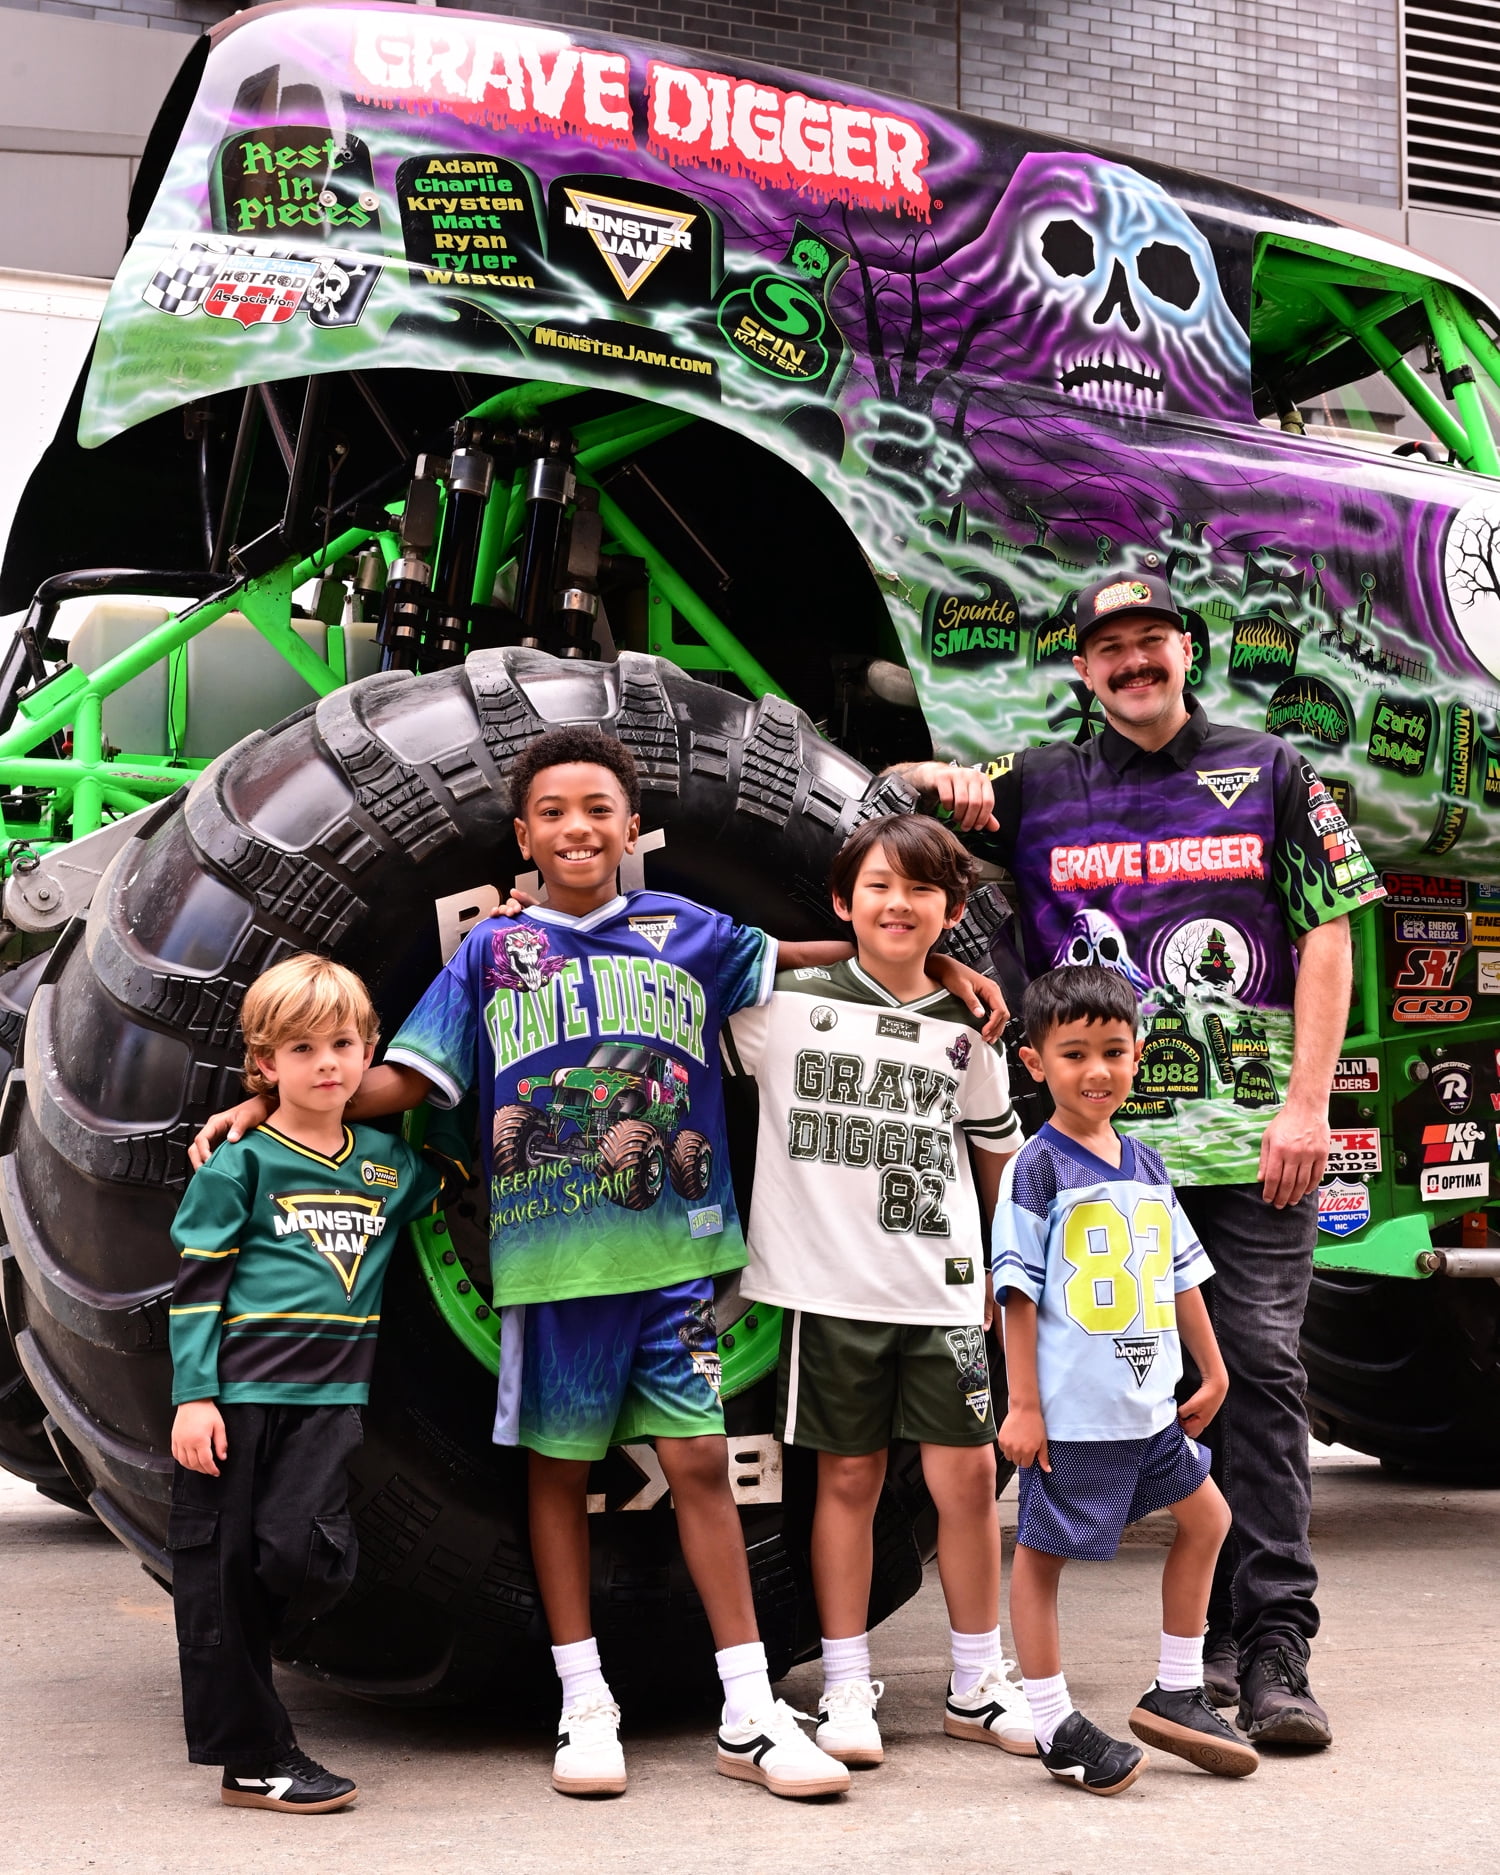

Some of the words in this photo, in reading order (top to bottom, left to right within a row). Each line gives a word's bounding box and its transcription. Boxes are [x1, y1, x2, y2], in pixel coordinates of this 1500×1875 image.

[353, 22, 631, 133] GRAVE
[650, 63, 924, 195] DIGGER
[239, 138, 343, 175] Rest
[426, 160, 498, 174] Adam
[279, 170, 314, 202] in
[414, 176, 513, 192] Charlie
[406, 196, 524, 213] Krysten
[235, 197, 371, 232] Pieces
[432, 215, 502, 230] Matt
[564, 206, 692, 251] MONSTER
[435, 234, 508, 252] Ryan
[599, 238, 658, 263] JAM
[431, 254, 518, 271] Tyler
[220, 270, 261, 284] HOT
[262, 274, 306, 289] ROD
[423, 270, 536, 289] Weston
[212, 289, 295, 309] Association
[740, 315, 807, 366] SPIN
[1099, 586, 1129, 600] GRAVE
[1099, 593, 1130, 609] DIGGER
[938, 596, 1016, 629] Sparkle
[933, 627, 1016, 658] SMASH
[1232, 641, 1295, 672] DRAGON
[1375, 705, 1426, 741] Earth
[1370, 733, 1425, 765] Shaker
[1449, 706, 1471, 796] MONSTER
[1198, 773, 1260, 787] MONSTER
[1214, 784, 1244, 793] JAM
[1051, 843, 1142, 883] GRAVE
[1147, 836, 1262, 874] DIGGER
[1386, 873, 1463, 897] DERALE
[1387, 894, 1463, 905] PERFORMANCE
[628, 922, 678, 932] MONSTER
[1429, 921, 1457, 931] ENERGY
[1475, 915, 1500, 927] ENE
[641, 929, 669, 938] JAM
[1429, 930, 1459, 940] RELEASE
[589, 955, 708, 1070] DIGGER
[1397, 998, 1469, 1014] CRD
[1155, 1017, 1182, 1030] RIP
[1207, 1016, 1227, 1057] MONSTER
[1139, 1037, 1201, 1064] ESTABLISHED
[1162, 1051, 1174, 1061] IN
[1140, 1063, 1199, 1084] 1982
[1334, 1061, 1363, 1075] OLN
[1241, 1071, 1271, 1088] Earth
[1332, 1078, 1371, 1090] LDERS
[1166, 1084, 1198, 1093] ANDERSON
[1237, 1086, 1275, 1101] Shaker
[1118, 1100, 1166, 1115] ZOMBIE
[1445, 1121, 1486, 1142] K&
[789, 1109, 956, 1181] DIGGER
[1450, 1141, 1475, 1161] N
[1328, 1151, 1377, 1161] ROD
[1325, 1161, 1378, 1172] NDS
[491, 1158, 572, 1203] KEEPING
[580, 1151, 602, 1170] THE
[1442, 1173, 1481, 1189] OPTIMA
[489, 1197, 557, 1239] SHOVEL
[562, 1168, 635, 1214] SHARP
[879, 1168, 951, 1237] 82
[1318, 1196, 1365, 1212] LUCAS
[273, 1209, 387, 1237] MONSTER
[1329, 1212, 1367, 1222] PRODUCTS
[317, 1233, 365, 1256] JAM
[1063, 1198, 1177, 1336] 82
[1116, 1345, 1159, 1357] MONSTER
[692, 1361, 722, 1375] MONS
[1132, 1356, 1152, 1366] JAM
